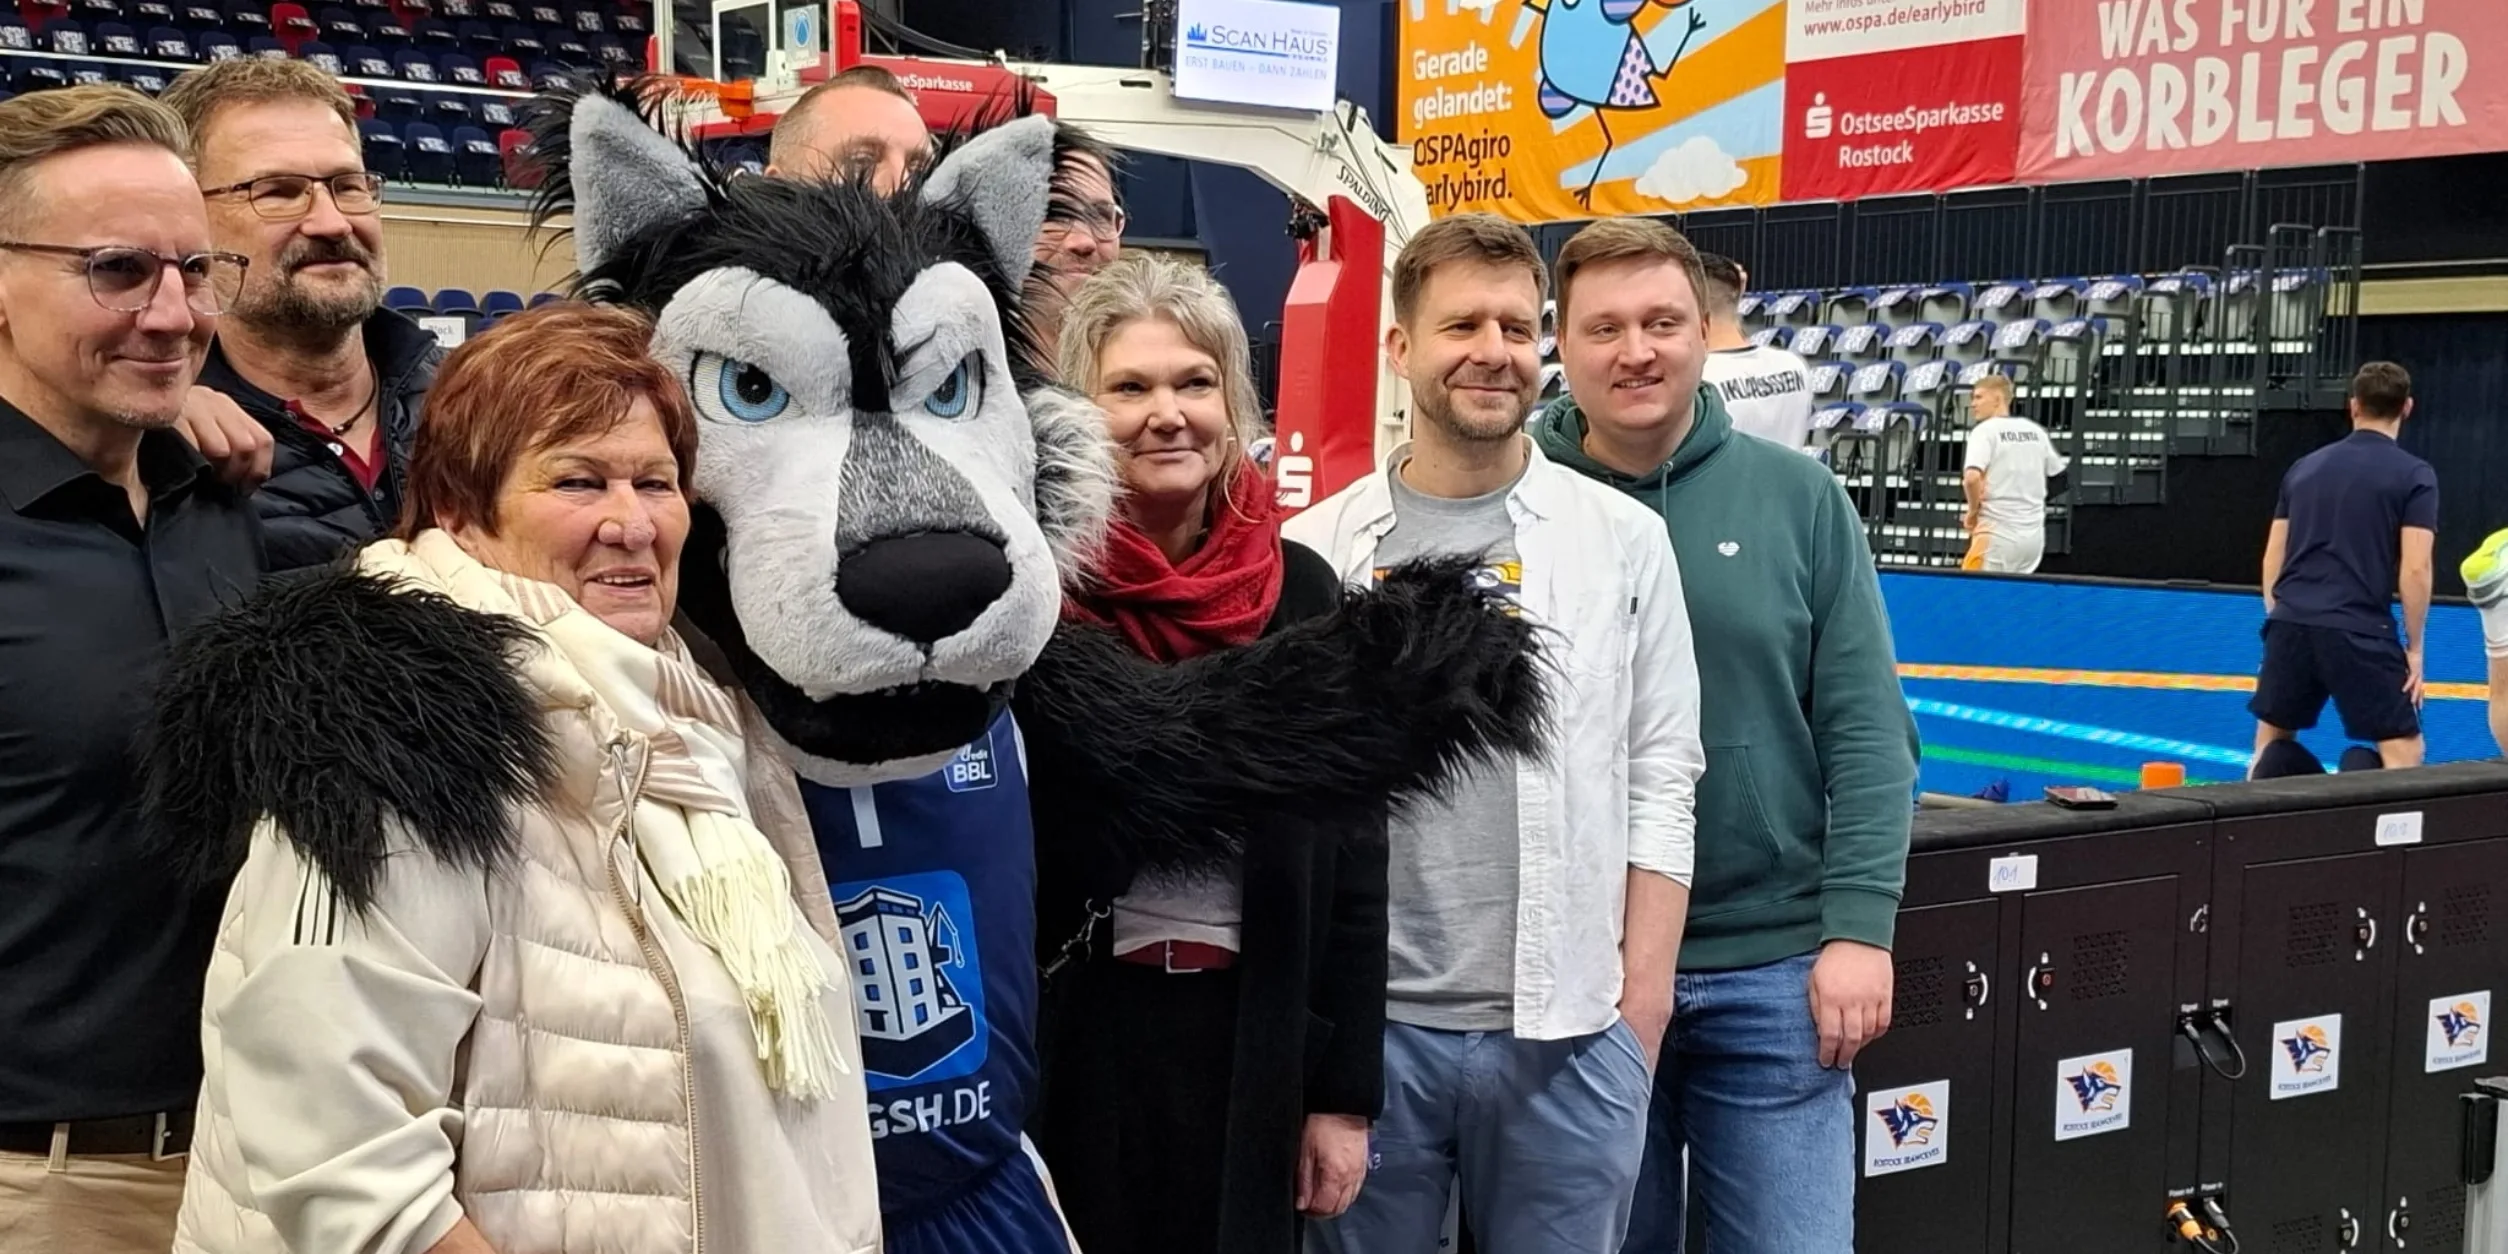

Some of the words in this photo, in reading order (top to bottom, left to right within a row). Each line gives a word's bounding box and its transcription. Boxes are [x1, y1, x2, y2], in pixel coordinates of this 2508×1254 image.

[1211, 25, 1267, 48] SCAN
[1804, 0, 1986, 36] www.ospa.de/earlybird
[2098, 0, 2199, 60] WAS
[2337, 0, 2425, 33] EIN
[1185, 55, 1208, 69] ERST
[1212, 58, 1246, 73] BAUEN
[1258, 62, 1286, 76] DANN
[1413, 40, 1488, 81] Gerade
[1413, 80, 1513, 130] gelandet:
[2054, 31, 2468, 159] KORBLEGER
[1840, 101, 2005, 136] OstseeSparkasse
[1413, 128, 1511, 169] OSPAgiro
[1839, 139, 1914, 169] Rostock
[1336, 164, 1391, 224] SPALDING
[1426, 168, 1513, 211] arlybird.
[953, 760, 992, 783] BBL
